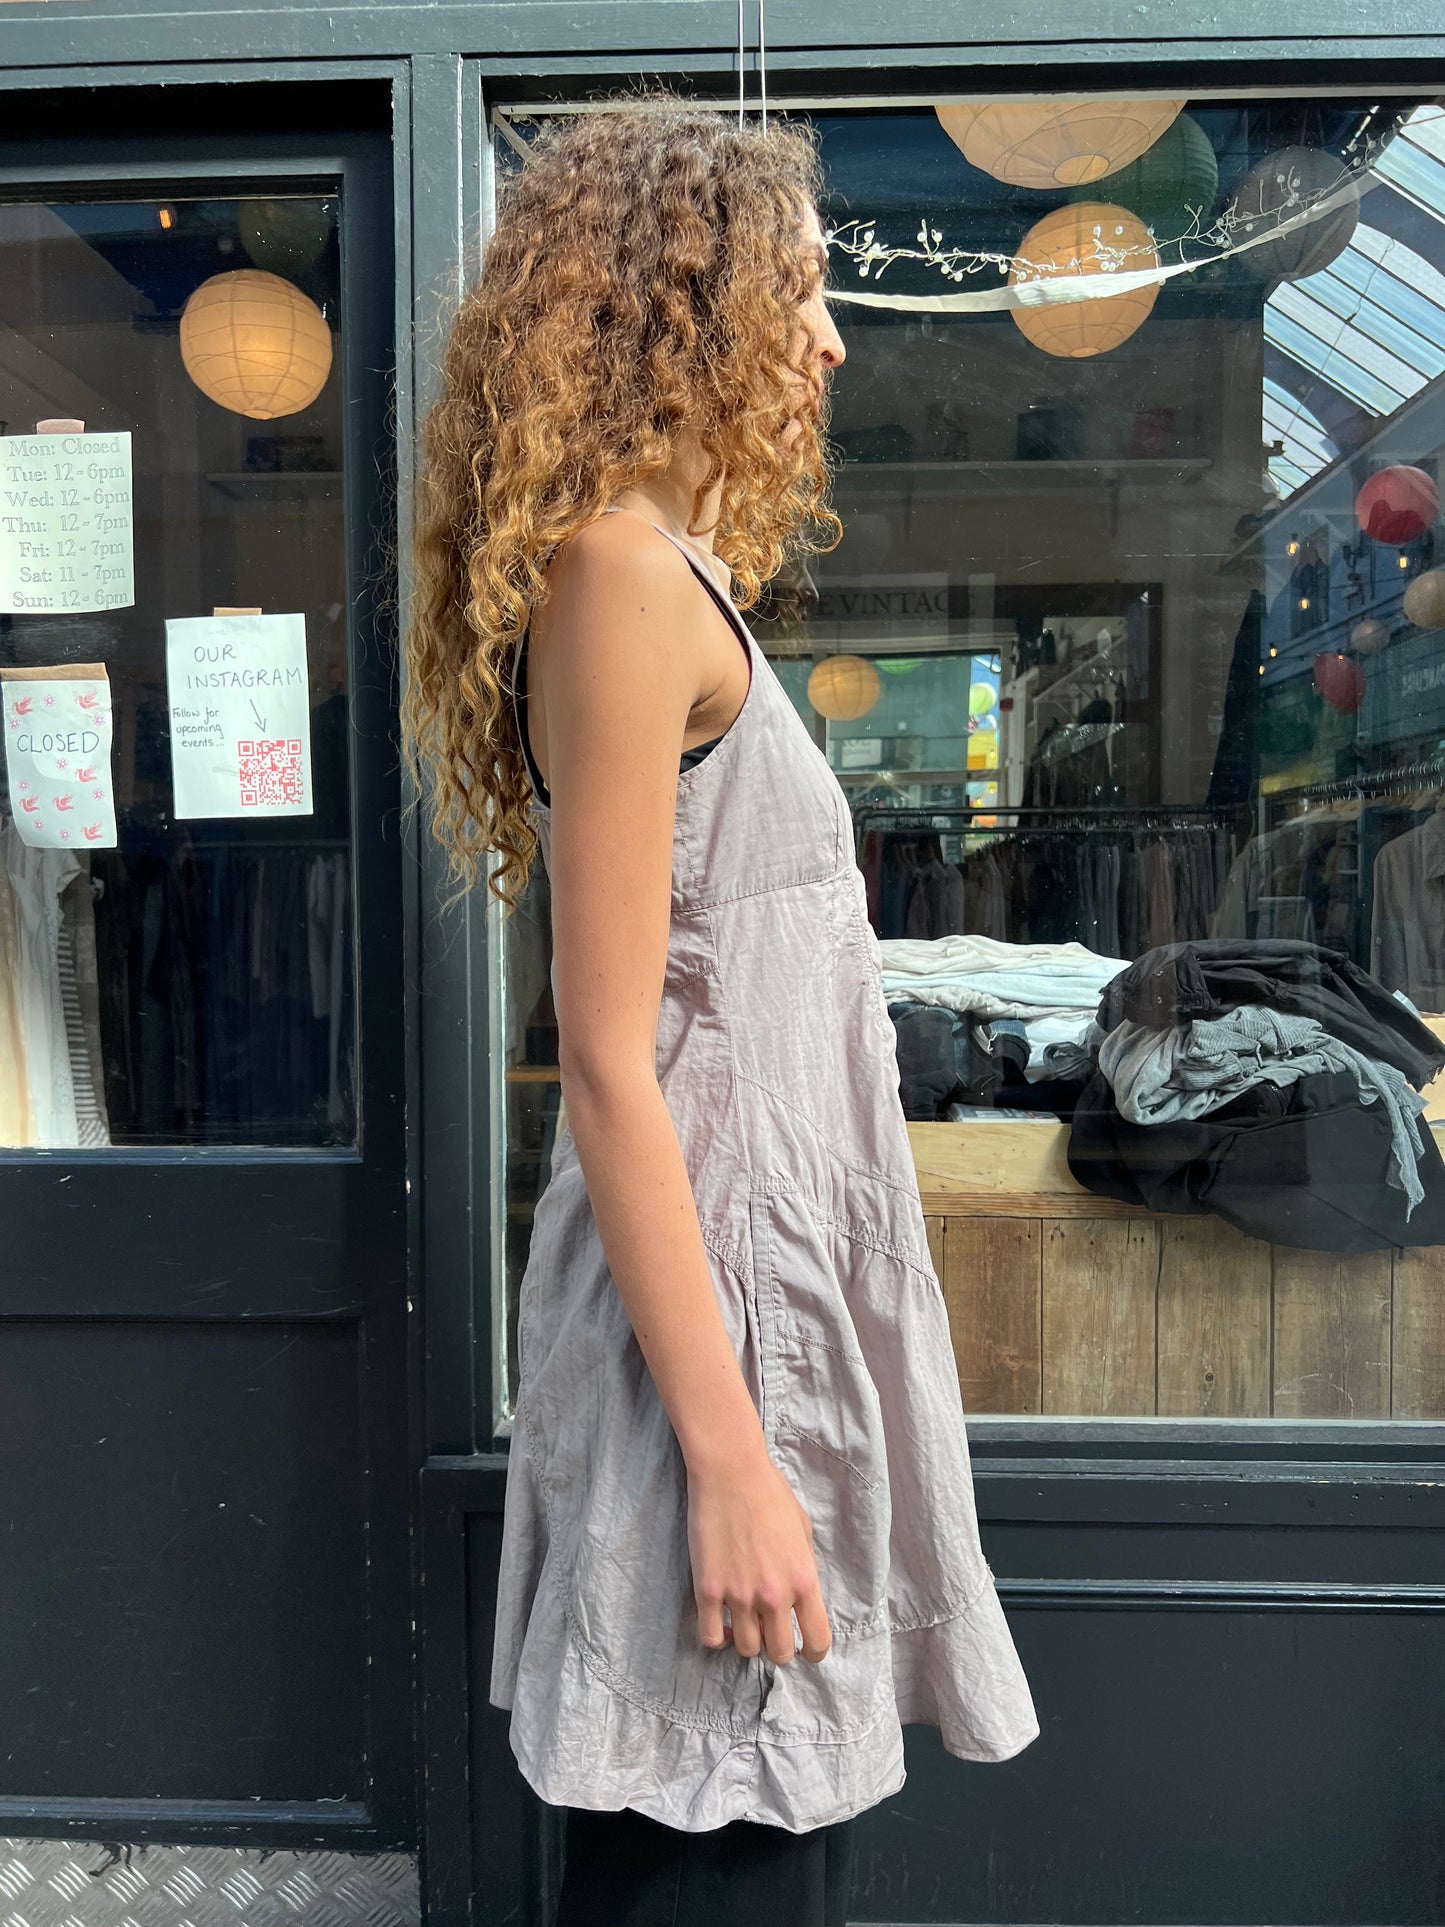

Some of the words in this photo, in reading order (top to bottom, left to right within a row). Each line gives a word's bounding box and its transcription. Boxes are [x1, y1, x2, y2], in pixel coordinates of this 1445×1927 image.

[8, 440, 56, 457] Mon:
[61, 437, 120, 455] Closed
[6, 465, 48, 482] Tue:
[4, 490, 54, 507] Wed:
[2, 516, 47, 533] Thu:
[18, 541, 50, 558] Fri:
[19, 566, 53, 583] Sat:
[12, 590, 54, 608] Sun:
[194, 643, 237, 663] OUR
[187, 666, 302, 689] INSTAGRAM
[172, 707, 201, 719] Follow
[203, 706, 220, 725] for
[175, 723, 225, 740] upcoming
[16, 731, 100, 754] CLOSED
